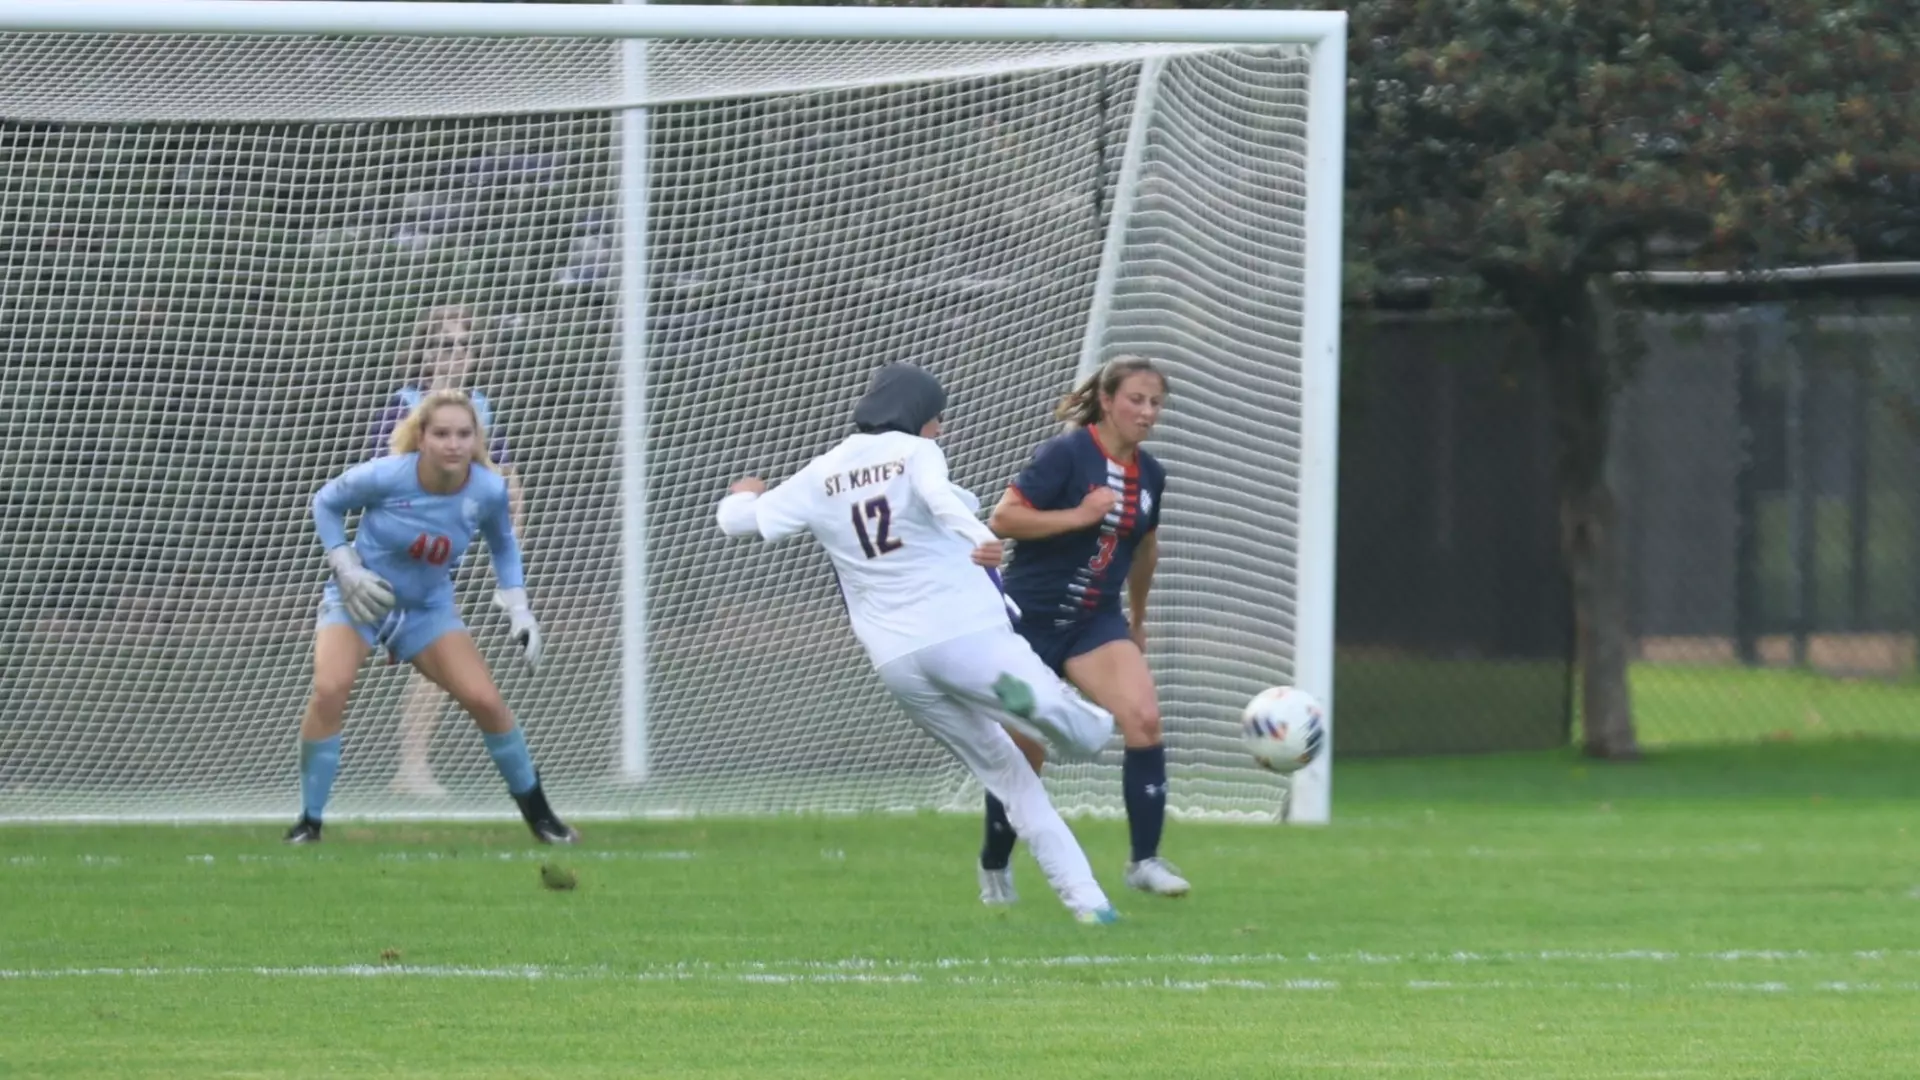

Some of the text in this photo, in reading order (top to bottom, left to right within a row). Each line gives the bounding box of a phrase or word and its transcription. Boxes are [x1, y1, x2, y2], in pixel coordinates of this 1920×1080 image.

[824, 473, 847, 496] ST.
[851, 494, 904, 560] 12
[408, 531, 452, 567] 40
[1088, 532, 1118, 572] 3
